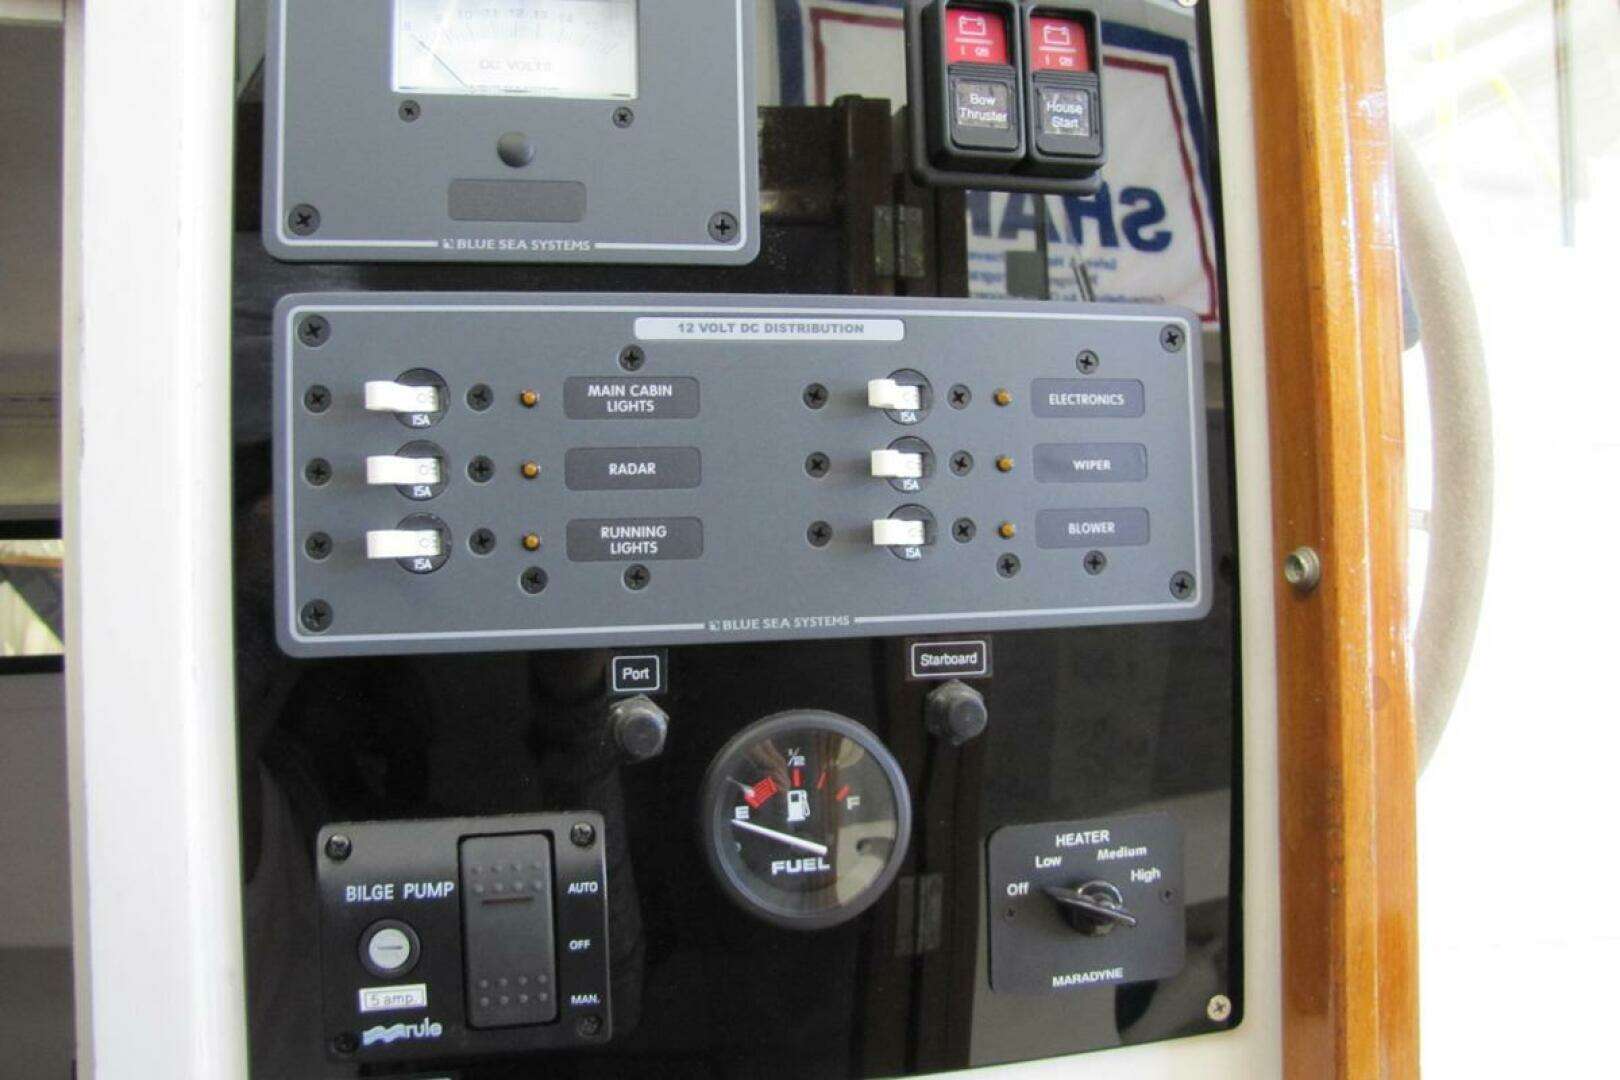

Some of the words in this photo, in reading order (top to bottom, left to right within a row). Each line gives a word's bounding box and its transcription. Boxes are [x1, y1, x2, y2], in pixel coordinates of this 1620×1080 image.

[969, 93, 996, 107] Bow
[959, 107, 1008, 123] Thruster
[1046, 101, 1083, 115] House
[1051, 115, 1079, 129] Start
[456, 238, 496, 249] BLUE
[499, 239, 528, 250] SEA
[530, 240, 591, 252] SYSTEMS
[678, 323, 694, 334] 12
[700, 323, 734, 334] VOLT
[740, 323, 759, 335] DC
[764, 323, 865, 335] DISTRIBUTION
[587, 384, 625, 398] MAIN
[630, 384, 673, 398] CABIN
[606, 399, 655, 413] LIGHTS
[1048, 393, 1126, 407] ELECTRONICS
[412, 413, 431, 427] 15A
[900, 410, 918, 423] 15A
[608, 461, 657, 477] RADAR
[1071, 459, 1112, 472] WIPER
[413, 484, 432, 498] 15A
[902, 478, 920, 492] 15A
[600, 524, 668, 540] RUNNING
[1067, 521, 1116, 536] BLOWER
[609, 541, 658, 555] LIGHTS
[904, 546, 922, 560] 15A
[414, 557, 433, 571] 15A
[722, 617, 760, 631] BLUE
[762, 616, 790, 630] SEA
[793, 614, 850, 628] SYSTEMS
[920, 652, 978, 667] Starboard
[622, 666, 651, 682] Port
[846, 796, 861, 810] F
[735, 805, 750, 820] E
[1055, 829, 1111, 848] HEATER
[1097, 845, 1148, 861] Medium
[771, 857, 831, 876] FUEL
[1035, 855, 1062, 869] Low
[1130, 867, 1162, 884] High
[345, 884, 394, 902] BILGE
[403, 881, 455, 900] PUMP
[567, 881, 599, 895] AUTO
[1006, 881, 1030, 896] Off
[568, 939, 591, 951] OFF
[1052, 967, 1124, 987] MARADYNE
[406, 1016, 443, 1039] rule
